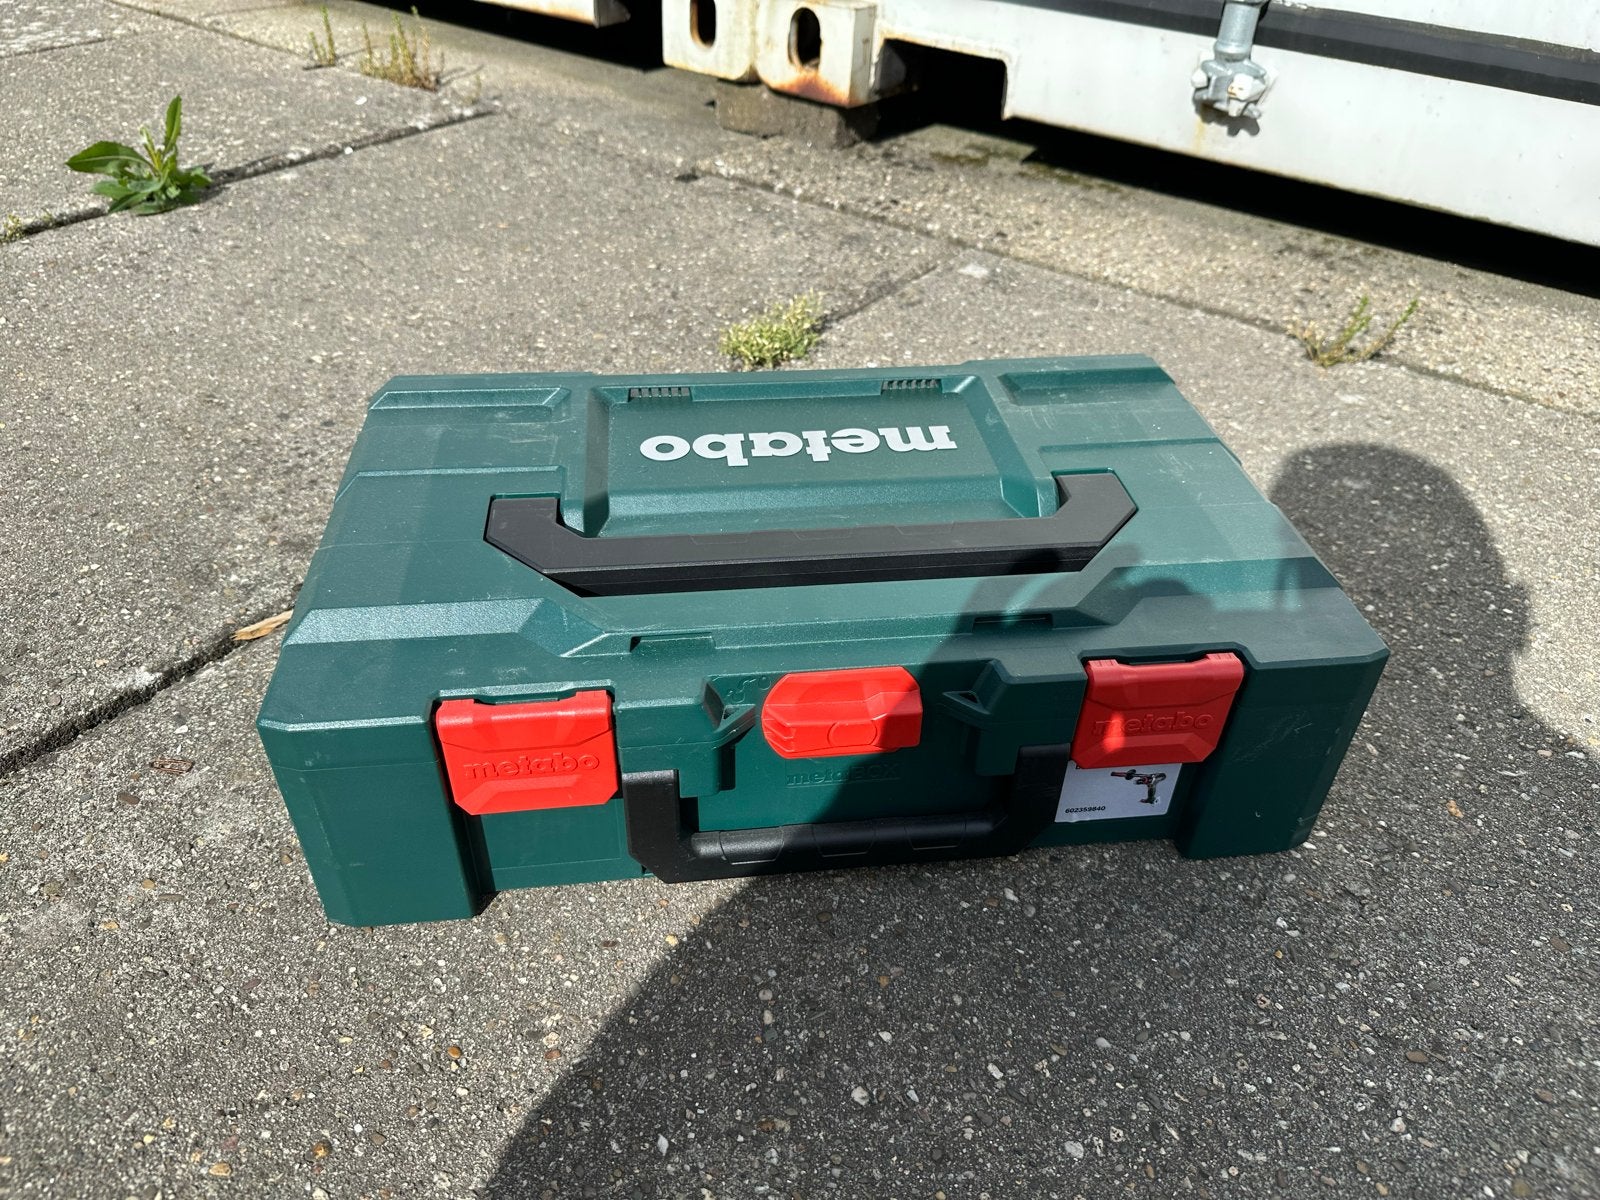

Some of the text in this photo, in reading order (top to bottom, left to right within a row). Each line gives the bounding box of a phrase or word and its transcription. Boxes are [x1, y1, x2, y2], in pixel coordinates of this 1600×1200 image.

[639, 425, 957, 466] metabo
[1091, 711, 1214, 735] metabo
[463, 752, 600, 779] metabo
[1065, 805, 1106, 814] 602359840
